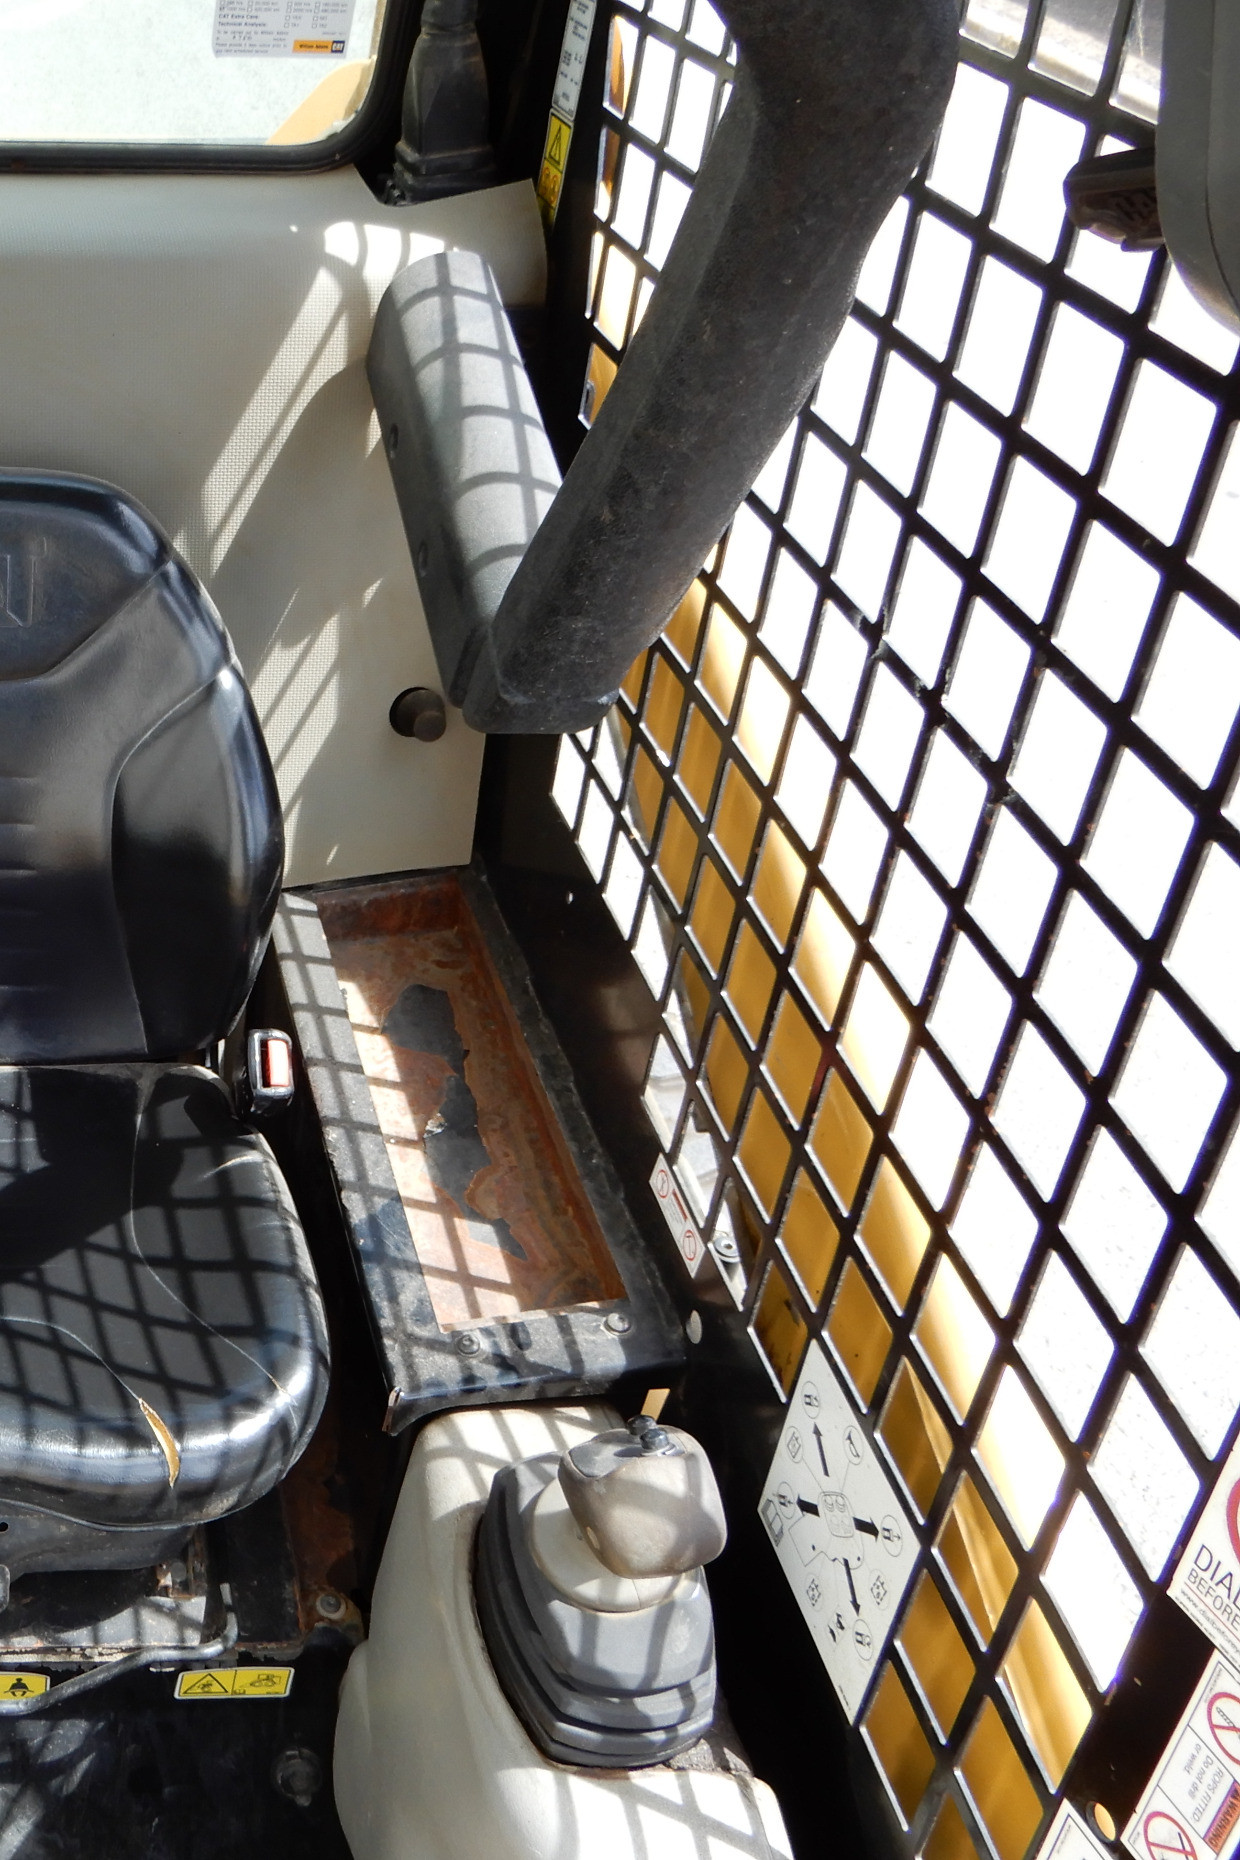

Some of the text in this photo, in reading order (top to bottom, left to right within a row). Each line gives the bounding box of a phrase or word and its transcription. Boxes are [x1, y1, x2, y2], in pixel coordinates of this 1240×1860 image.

[1187, 1568, 1240, 1631] BEFORE
[1203, 1755, 1214, 1769] Do
[1196, 1767, 1206, 1784] not
[1207, 1767, 1224, 1793] ROPS
[1208, 1800, 1237, 1847] WARNING
